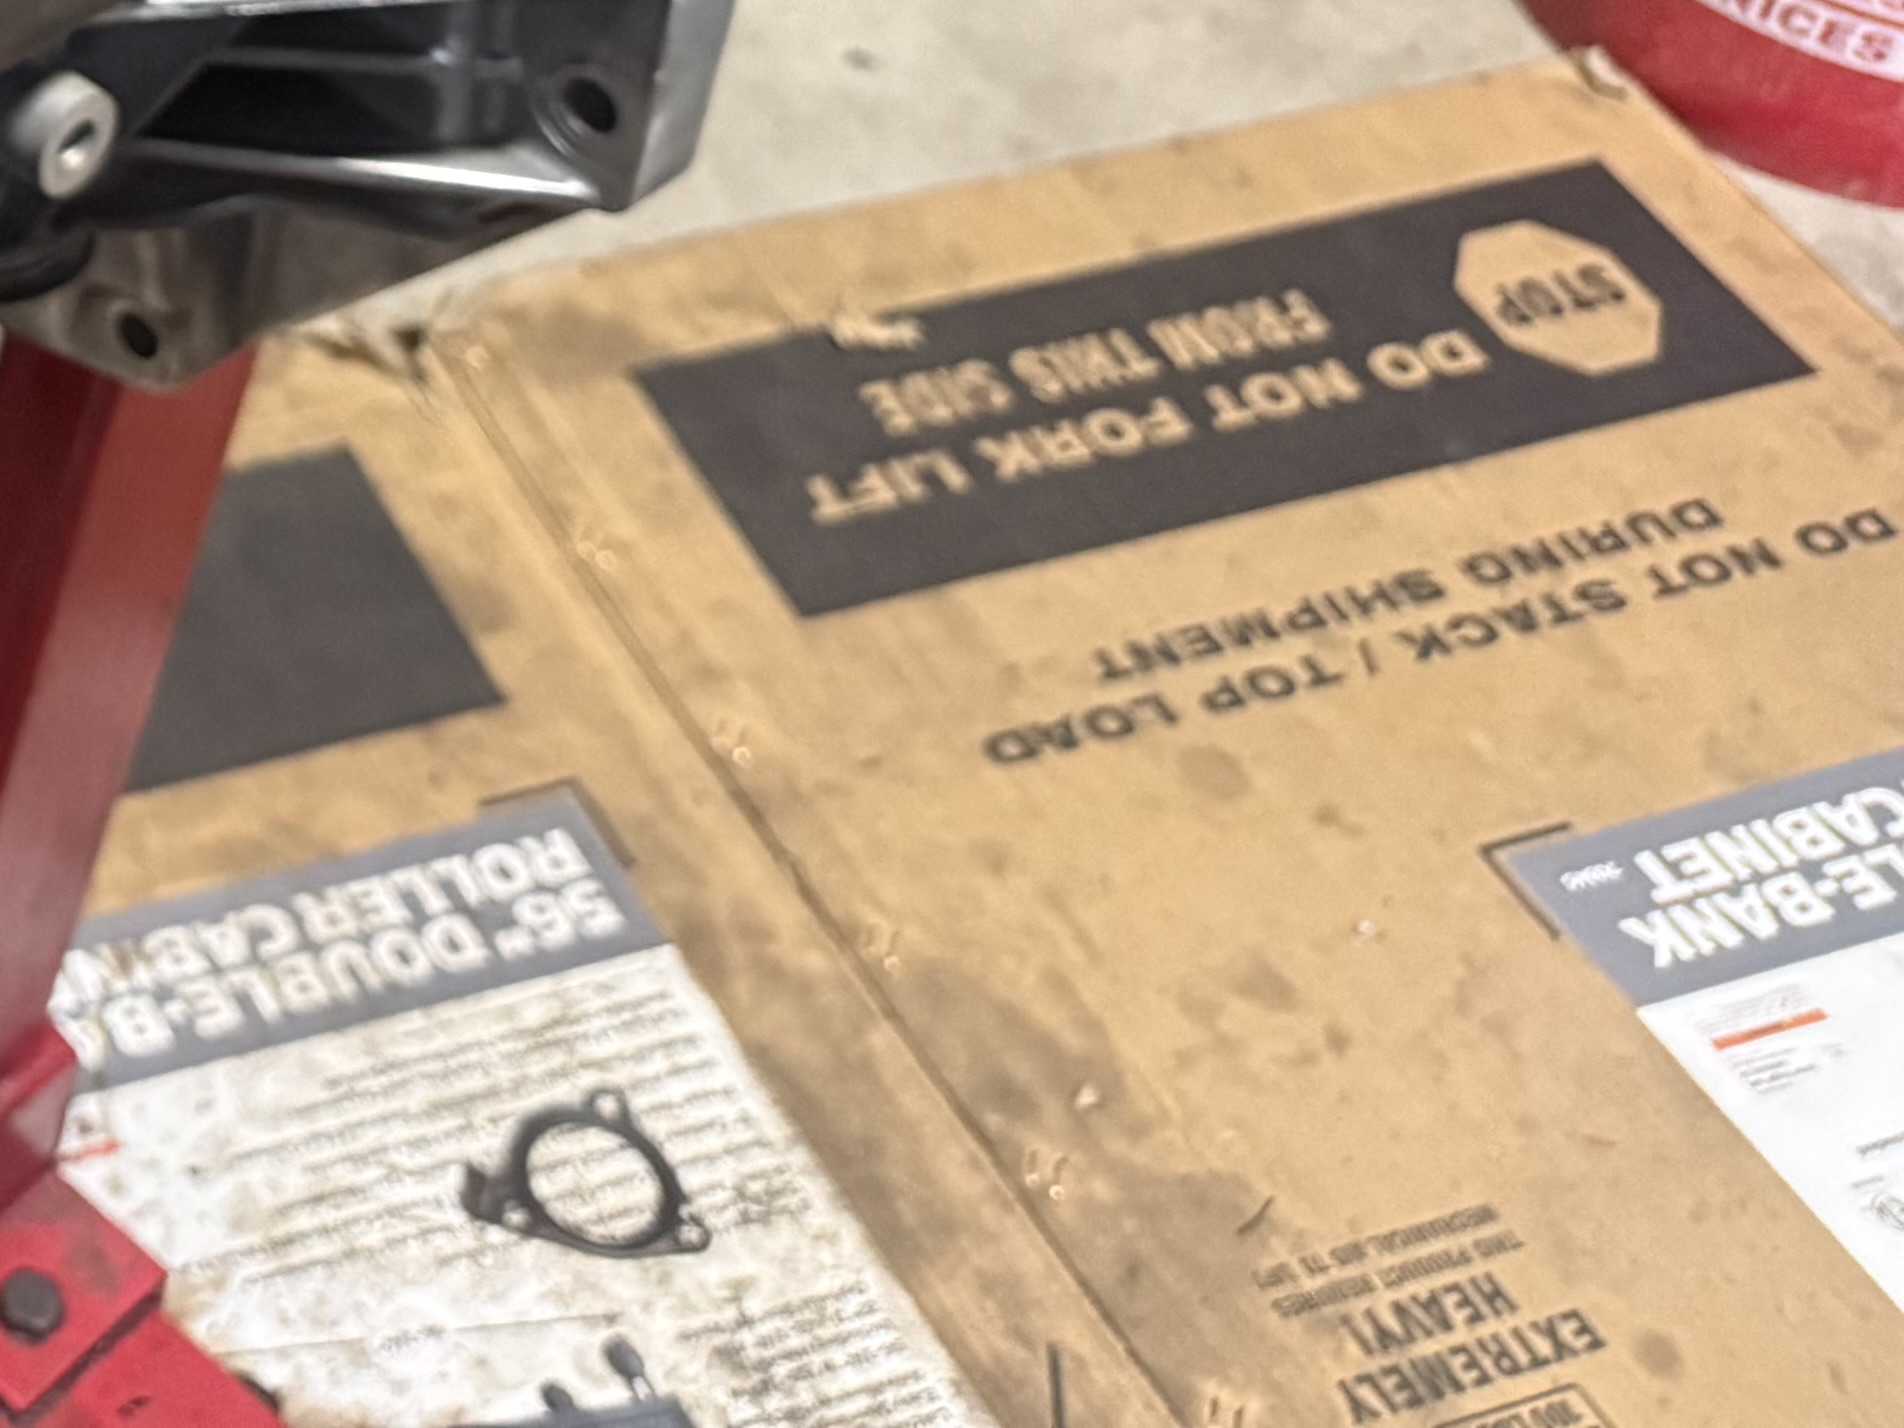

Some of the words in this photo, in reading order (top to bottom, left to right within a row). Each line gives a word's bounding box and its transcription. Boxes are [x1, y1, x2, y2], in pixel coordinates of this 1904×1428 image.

[1159, 286, 1334, 376] FROM
[1490, 257, 1630, 330] STOP
[856, 356, 990, 439] SIDE
[1008, 332, 1147, 401] THIS
[1203, 356, 1359, 432] NOT
[1374, 331, 1490, 388] DO
[988, 402, 1193, 484] FORK
[805, 450, 973, 526] LIFT
[1462, 495, 1726, 586] DURING
[1652, 534, 1784, 603] NOT
[1794, 506, 1900, 560] DO
[1095, 560, 1448, 685] SHIPMENT
[1411, 574, 1629, 665] STACK
[979, 686, 1184, 768] LOAD
[1203, 655, 1350, 718] TOP
[1634, 784, 1904, 901] CABINET
[286, 823, 592, 946] ROLLER
[493, 877, 630, 963] 56"
[1339, 1269, 1522, 1352] HEAVY!
[1334, 1304, 1608, 1428] EXTREMELY
